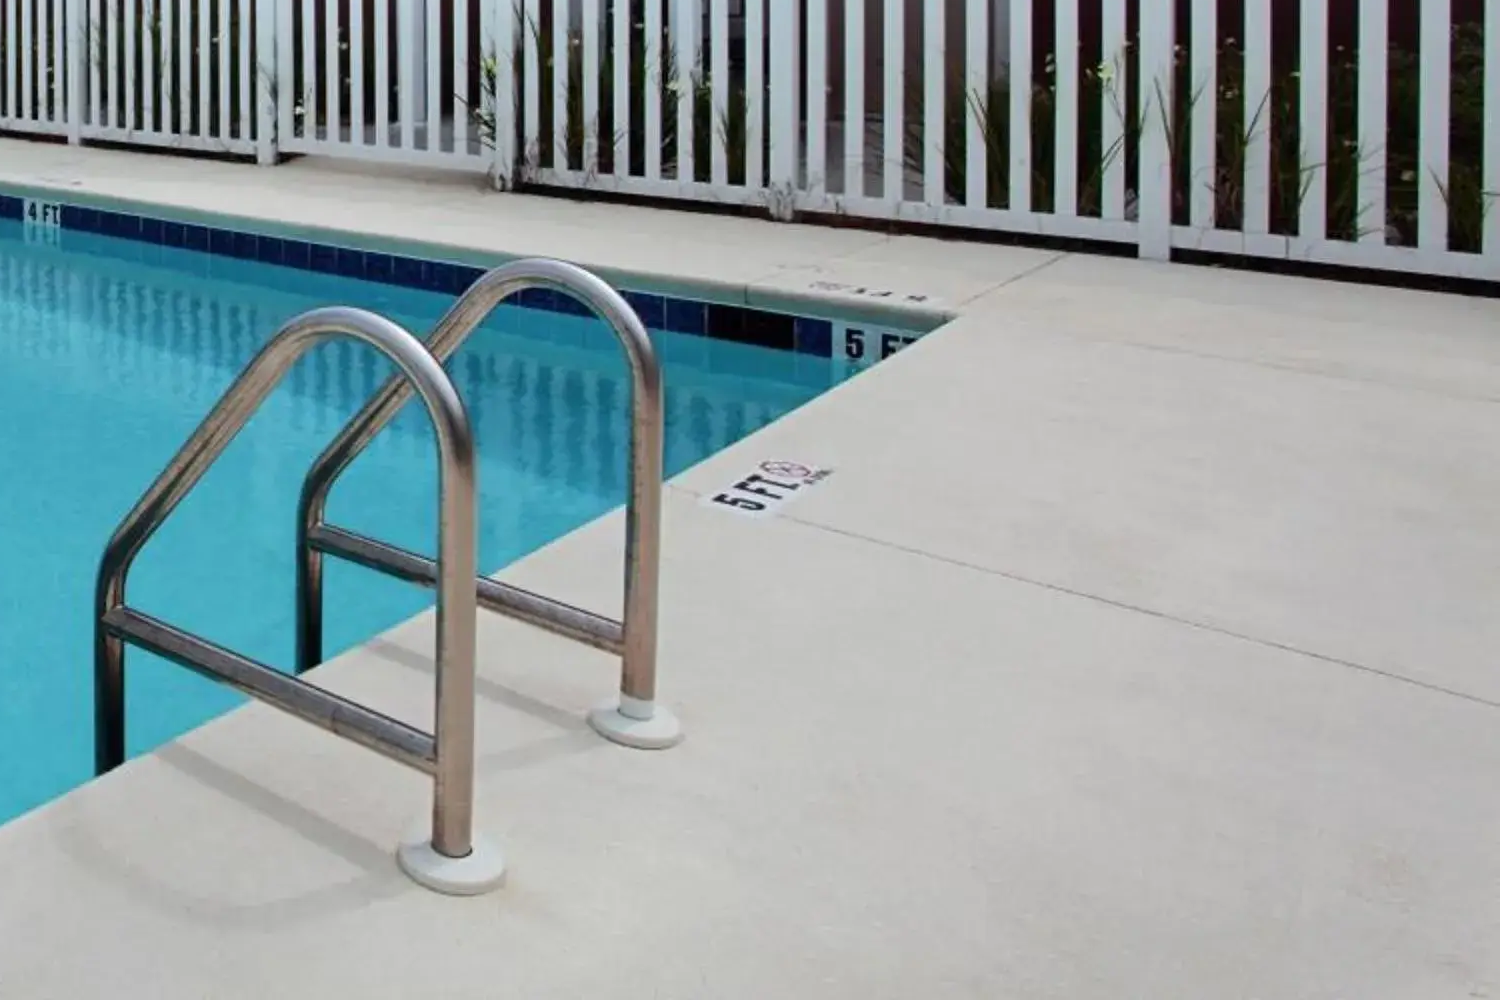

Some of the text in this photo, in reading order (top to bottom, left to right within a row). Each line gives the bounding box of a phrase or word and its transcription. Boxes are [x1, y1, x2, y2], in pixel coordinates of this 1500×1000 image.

[28, 202, 59, 225] 4 FT
[844, 327, 865, 359] 5
[712, 493, 766, 511] 5
